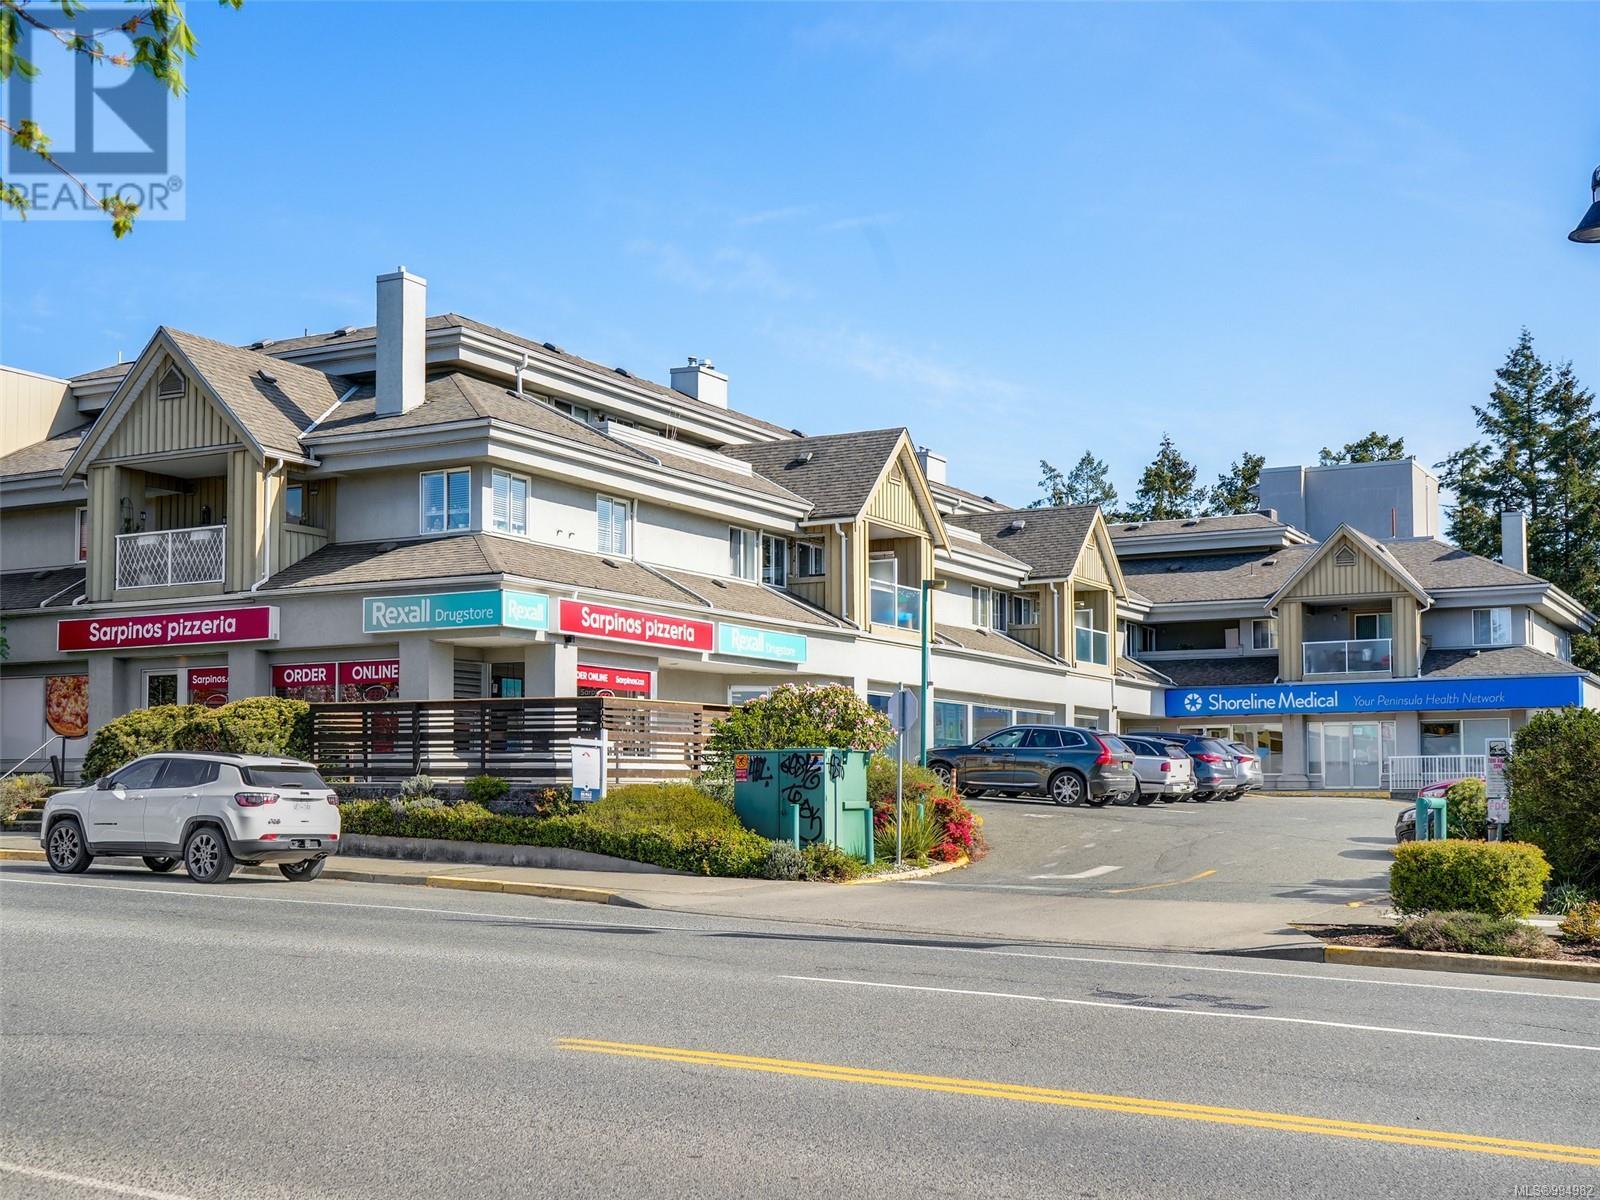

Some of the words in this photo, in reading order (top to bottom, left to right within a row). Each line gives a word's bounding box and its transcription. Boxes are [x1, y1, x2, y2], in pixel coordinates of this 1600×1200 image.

[372, 599, 430, 628] Rexall
[435, 608, 493, 623] Drugstore
[509, 601, 544, 621] Rexall
[168, 616, 236, 641] pizzeria
[646, 619, 695, 642] pizzeria
[732, 627, 764, 651] Rexall
[284, 668, 327, 683] ORDER
[352, 665, 399, 680] ONLINE
[588, 672, 609, 683] ONLINE
[1208, 693, 1275, 710] Shoreline
[1278, 690, 1338, 708] Medical
[1353, 696, 1374, 706] Your
[1377, 694, 1422, 706] Peninsula
[1426, 693, 1458, 704] Health
[1463, 691, 1505, 703] Network
